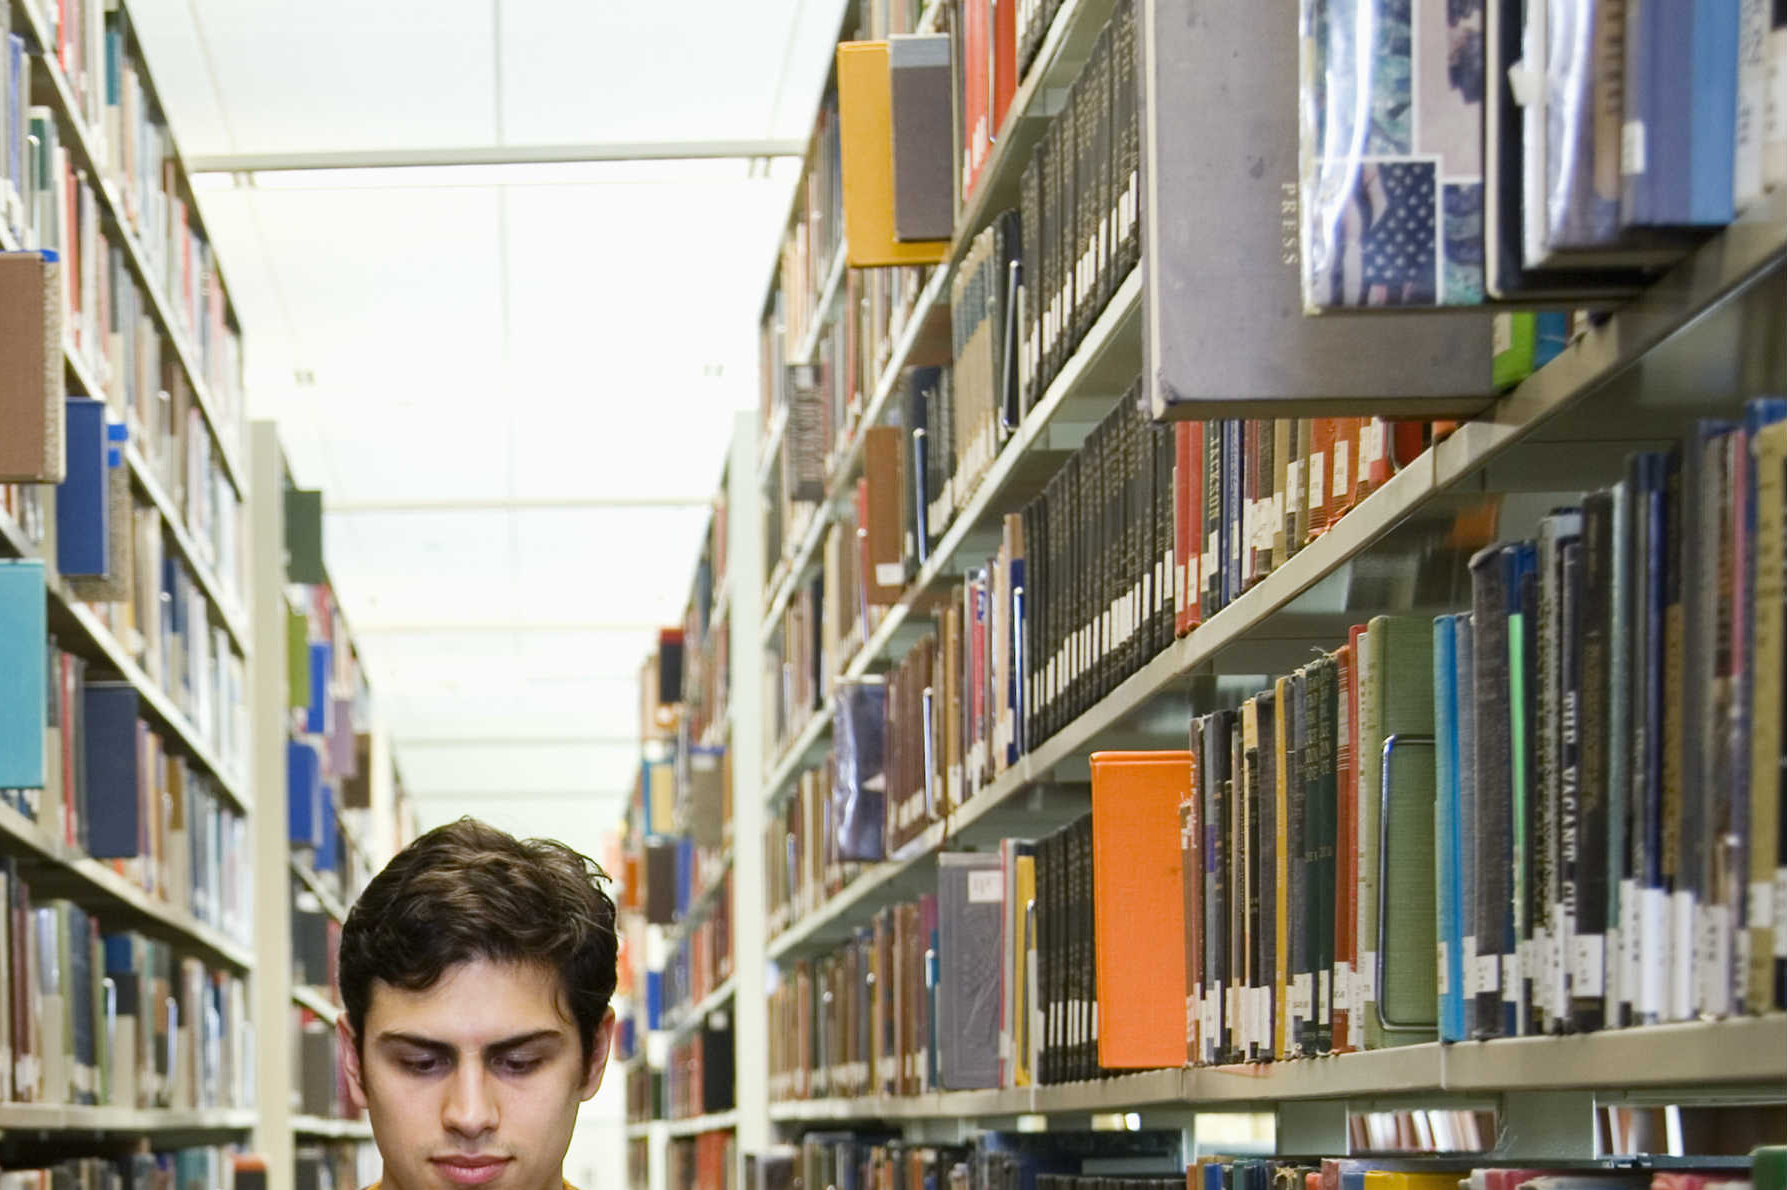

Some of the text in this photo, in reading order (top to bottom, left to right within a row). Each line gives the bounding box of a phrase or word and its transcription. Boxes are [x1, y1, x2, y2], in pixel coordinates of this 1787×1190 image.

[1281, 183, 1298, 265] PRESS
[1209, 437, 1221, 520] JACKSON
[1562, 691, 1578, 745] THE
[1562, 766, 1577, 862] VACANT
